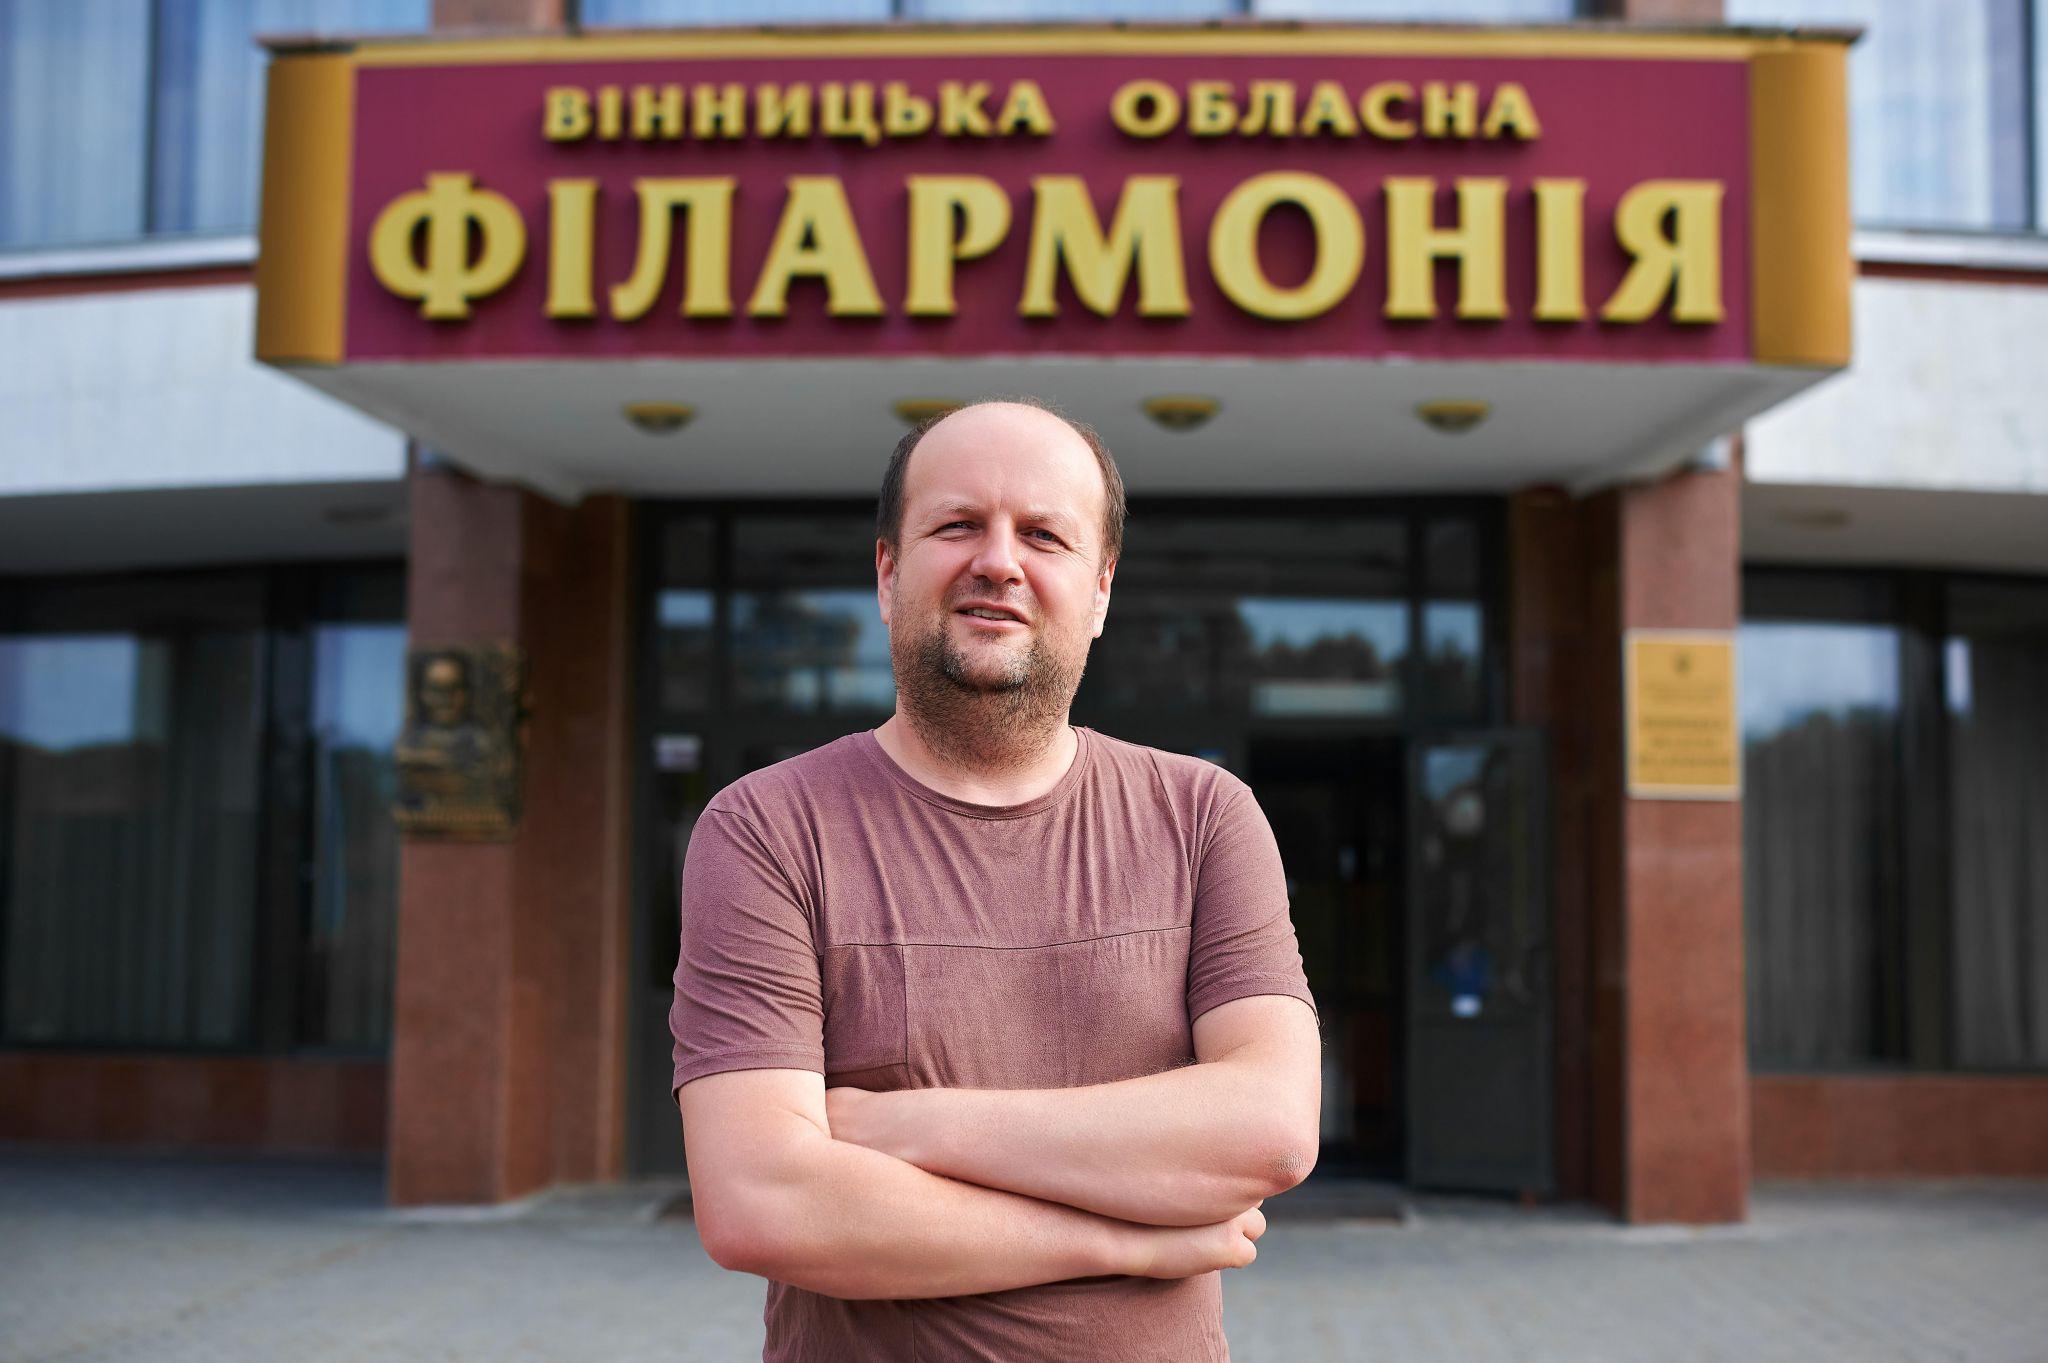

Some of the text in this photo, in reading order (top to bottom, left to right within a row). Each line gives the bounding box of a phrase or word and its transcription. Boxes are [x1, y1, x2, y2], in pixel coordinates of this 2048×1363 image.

[543, 80, 1542, 146] ВІННИЦЬКА ОБЛАСНА
[368, 170, 1725, 323] ФІЛАРМОНІЯ
